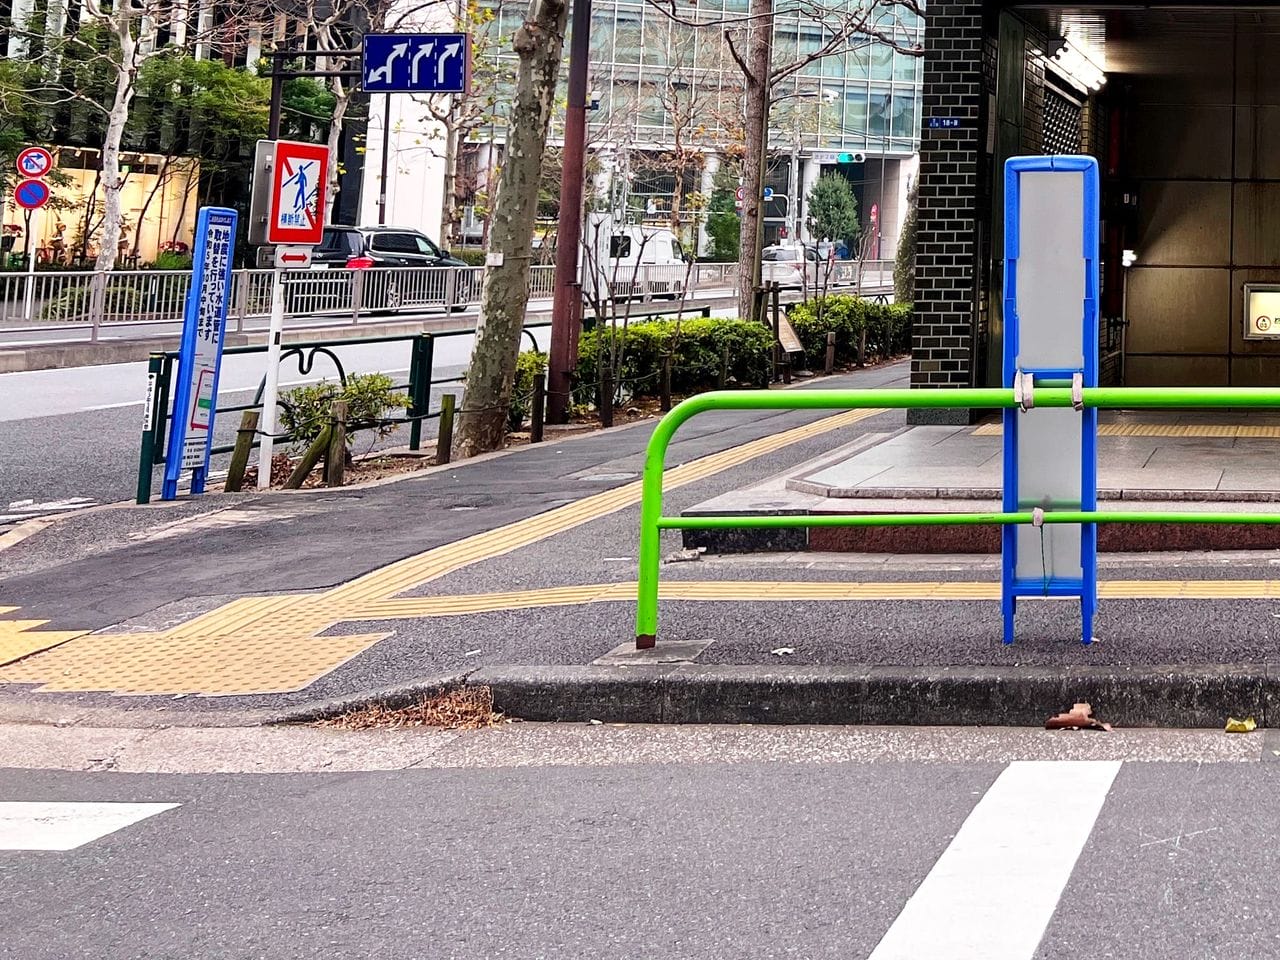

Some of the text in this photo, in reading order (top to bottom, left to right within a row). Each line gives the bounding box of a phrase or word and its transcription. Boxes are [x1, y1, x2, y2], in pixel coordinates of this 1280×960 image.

[204, 228, 222, 341] 取替を行っています
